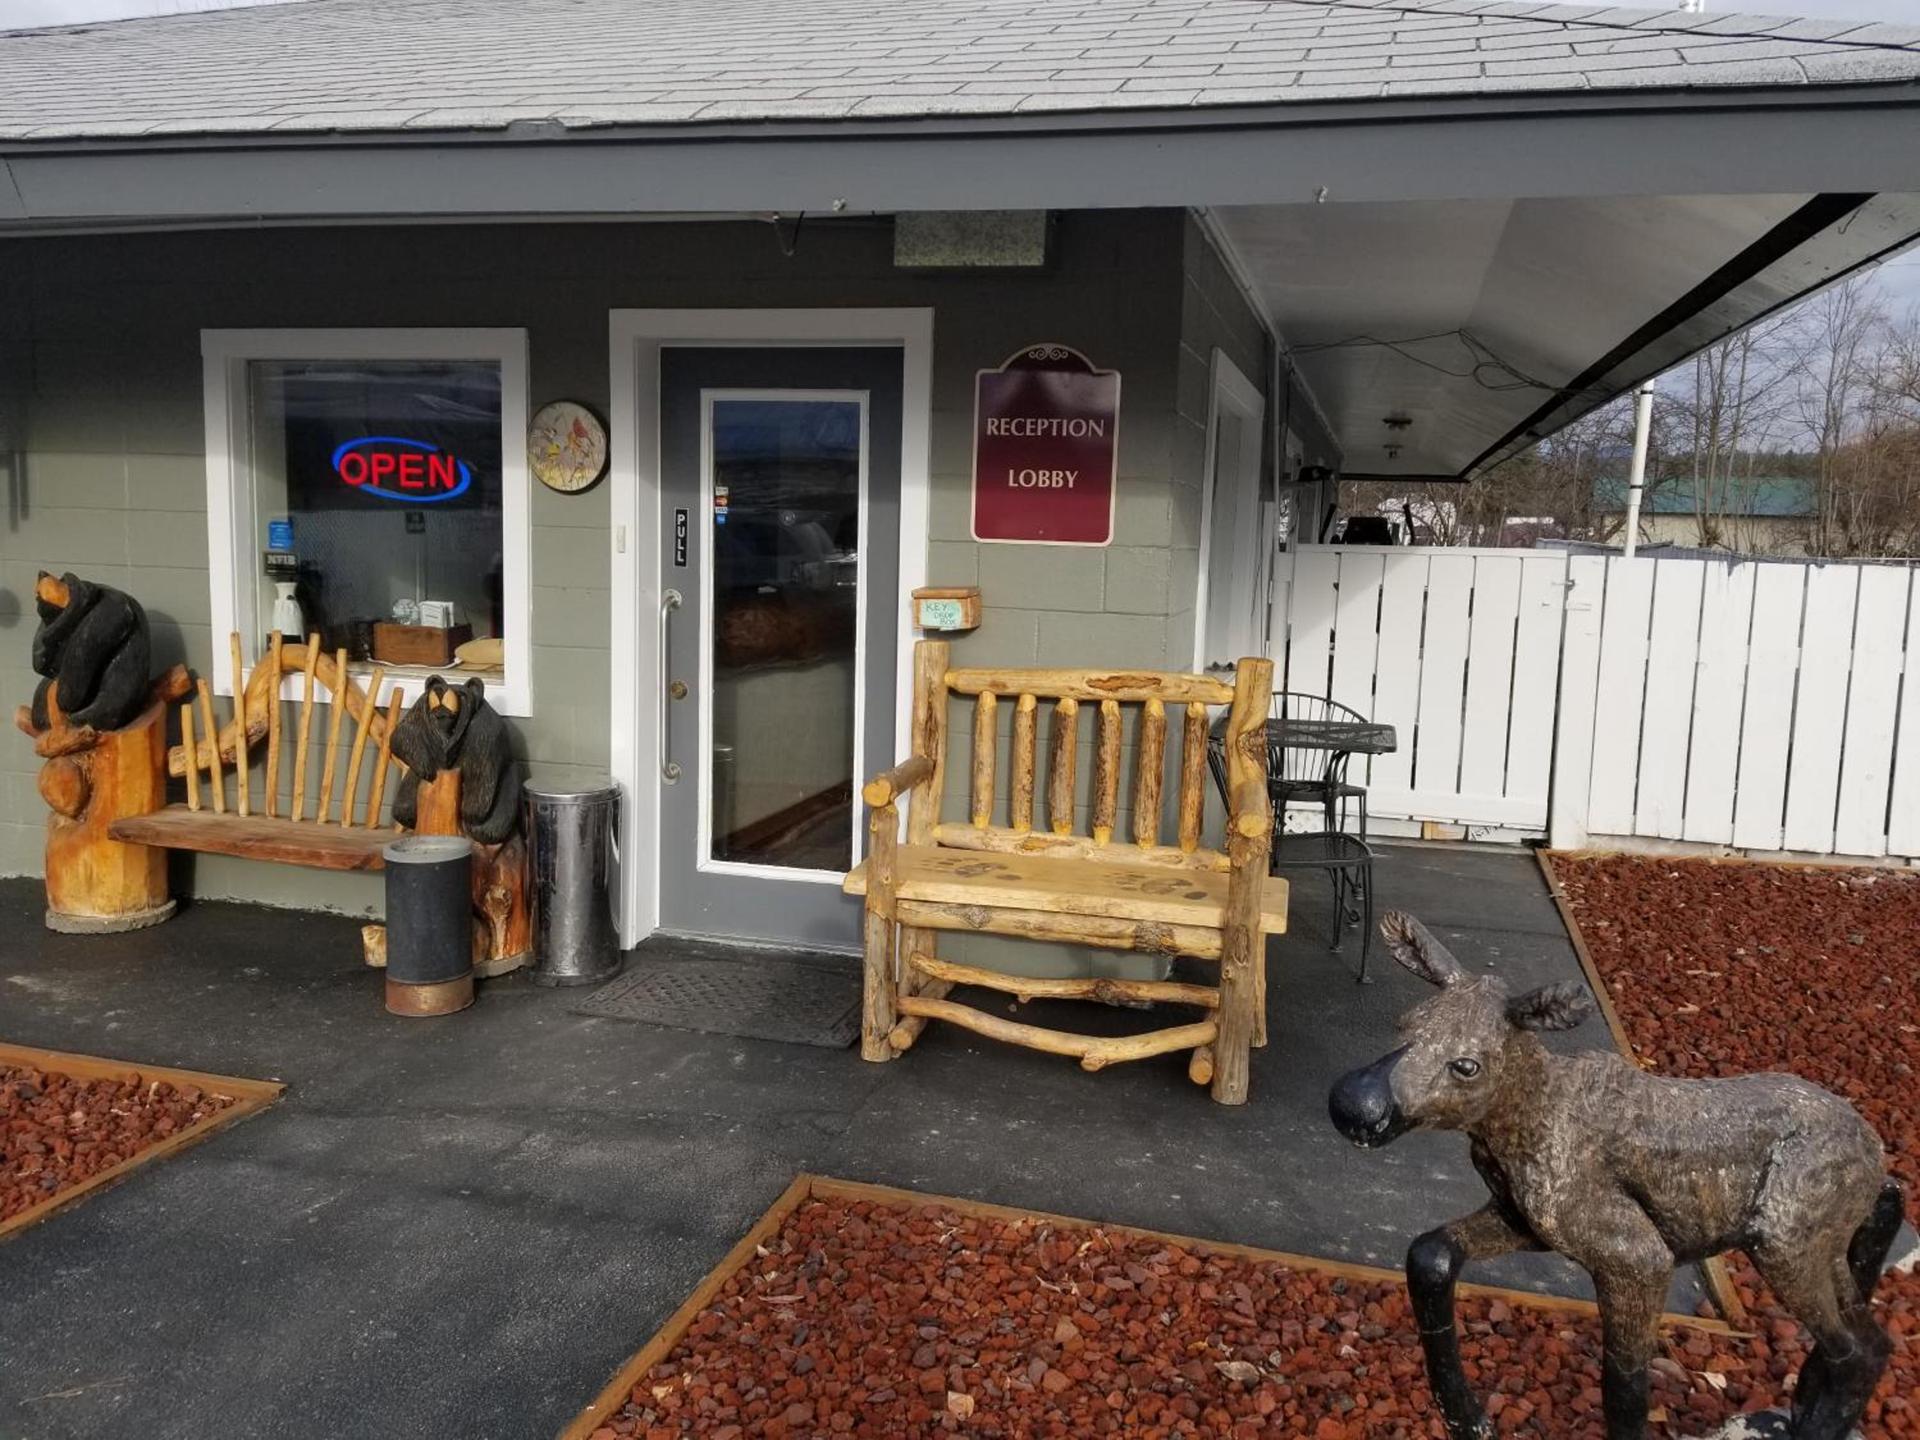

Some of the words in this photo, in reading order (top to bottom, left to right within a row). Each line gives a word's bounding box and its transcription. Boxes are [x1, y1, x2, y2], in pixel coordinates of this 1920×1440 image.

[986, 417, 1105, 438] RECEPTION
[339, 452, 456, 489] OPEN
[1007, 468, 1079, 489] LOBBY
[676, 513, 686, 563] PULL
[925, 602, 947, 612] KEY
